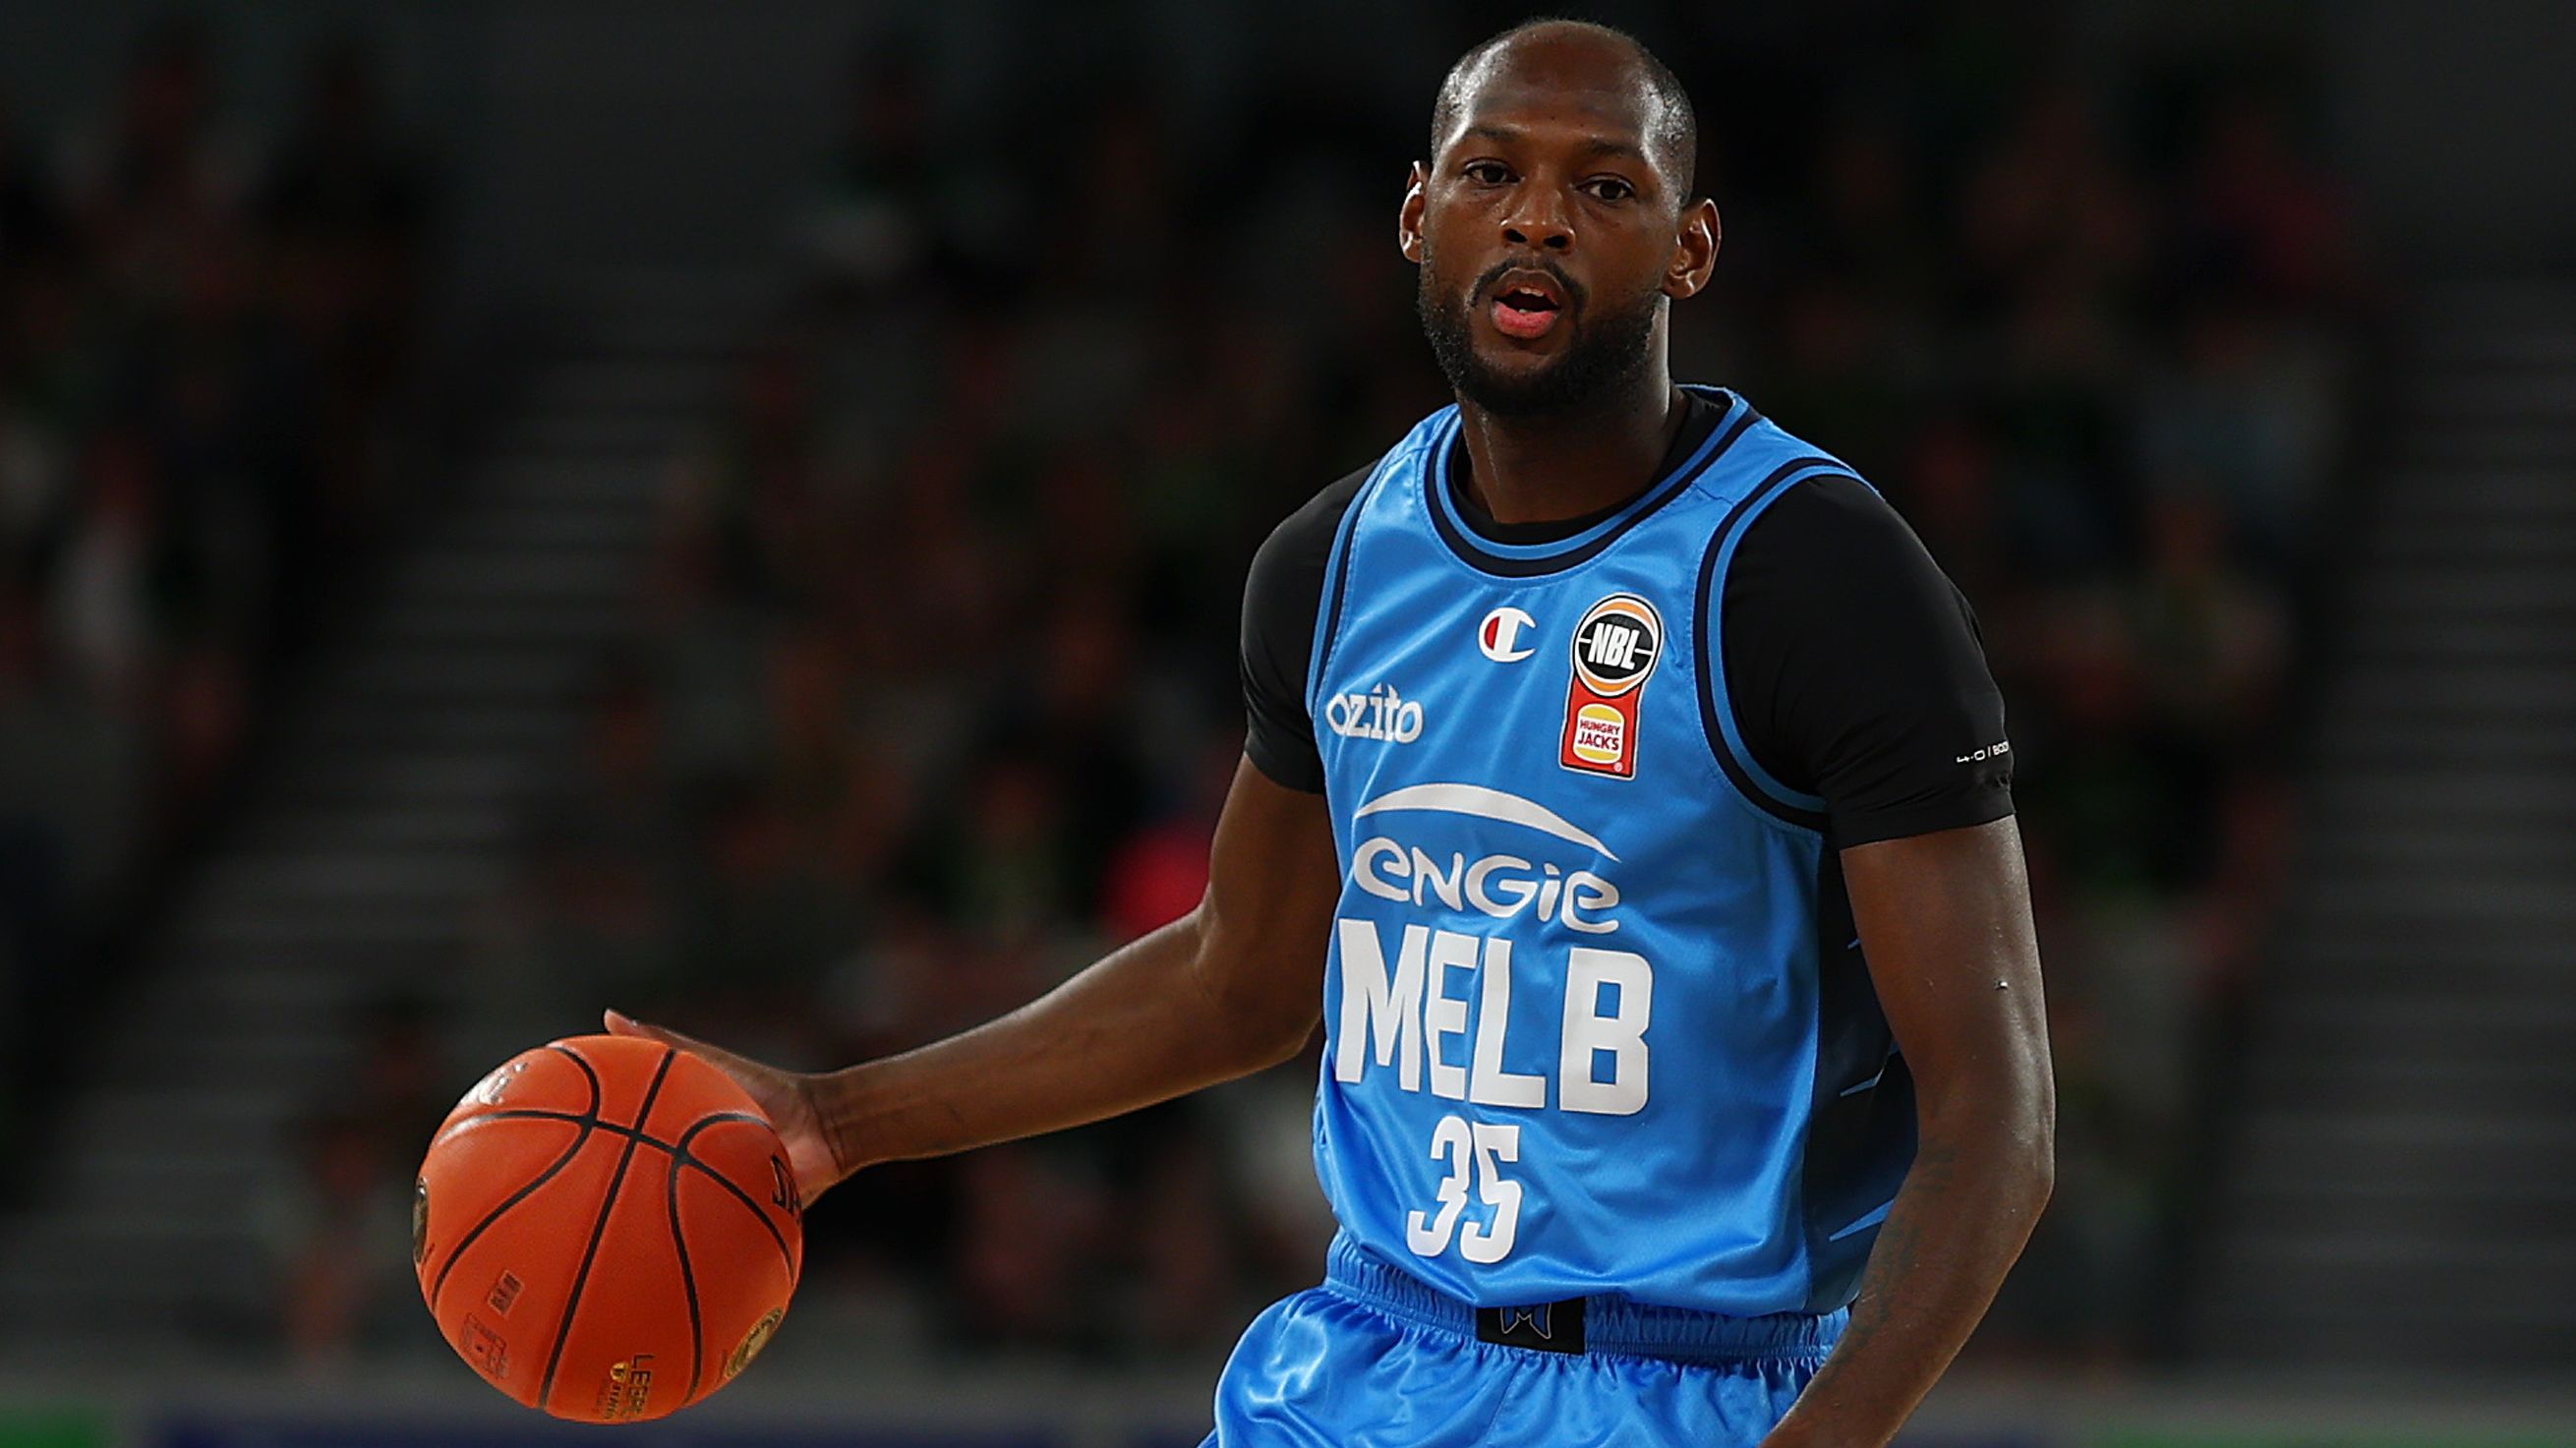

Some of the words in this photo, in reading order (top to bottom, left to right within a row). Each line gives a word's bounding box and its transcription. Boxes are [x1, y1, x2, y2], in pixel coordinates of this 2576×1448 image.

[1588, 622, 1640, 670] NBL
[1325, 682, 1424, 744] ozito
[1580, 719, 1620, 735] HUNGRY
[1335, 918, 1653, 1116] MELB
[1406, 1116, 1522, 1264] 35
